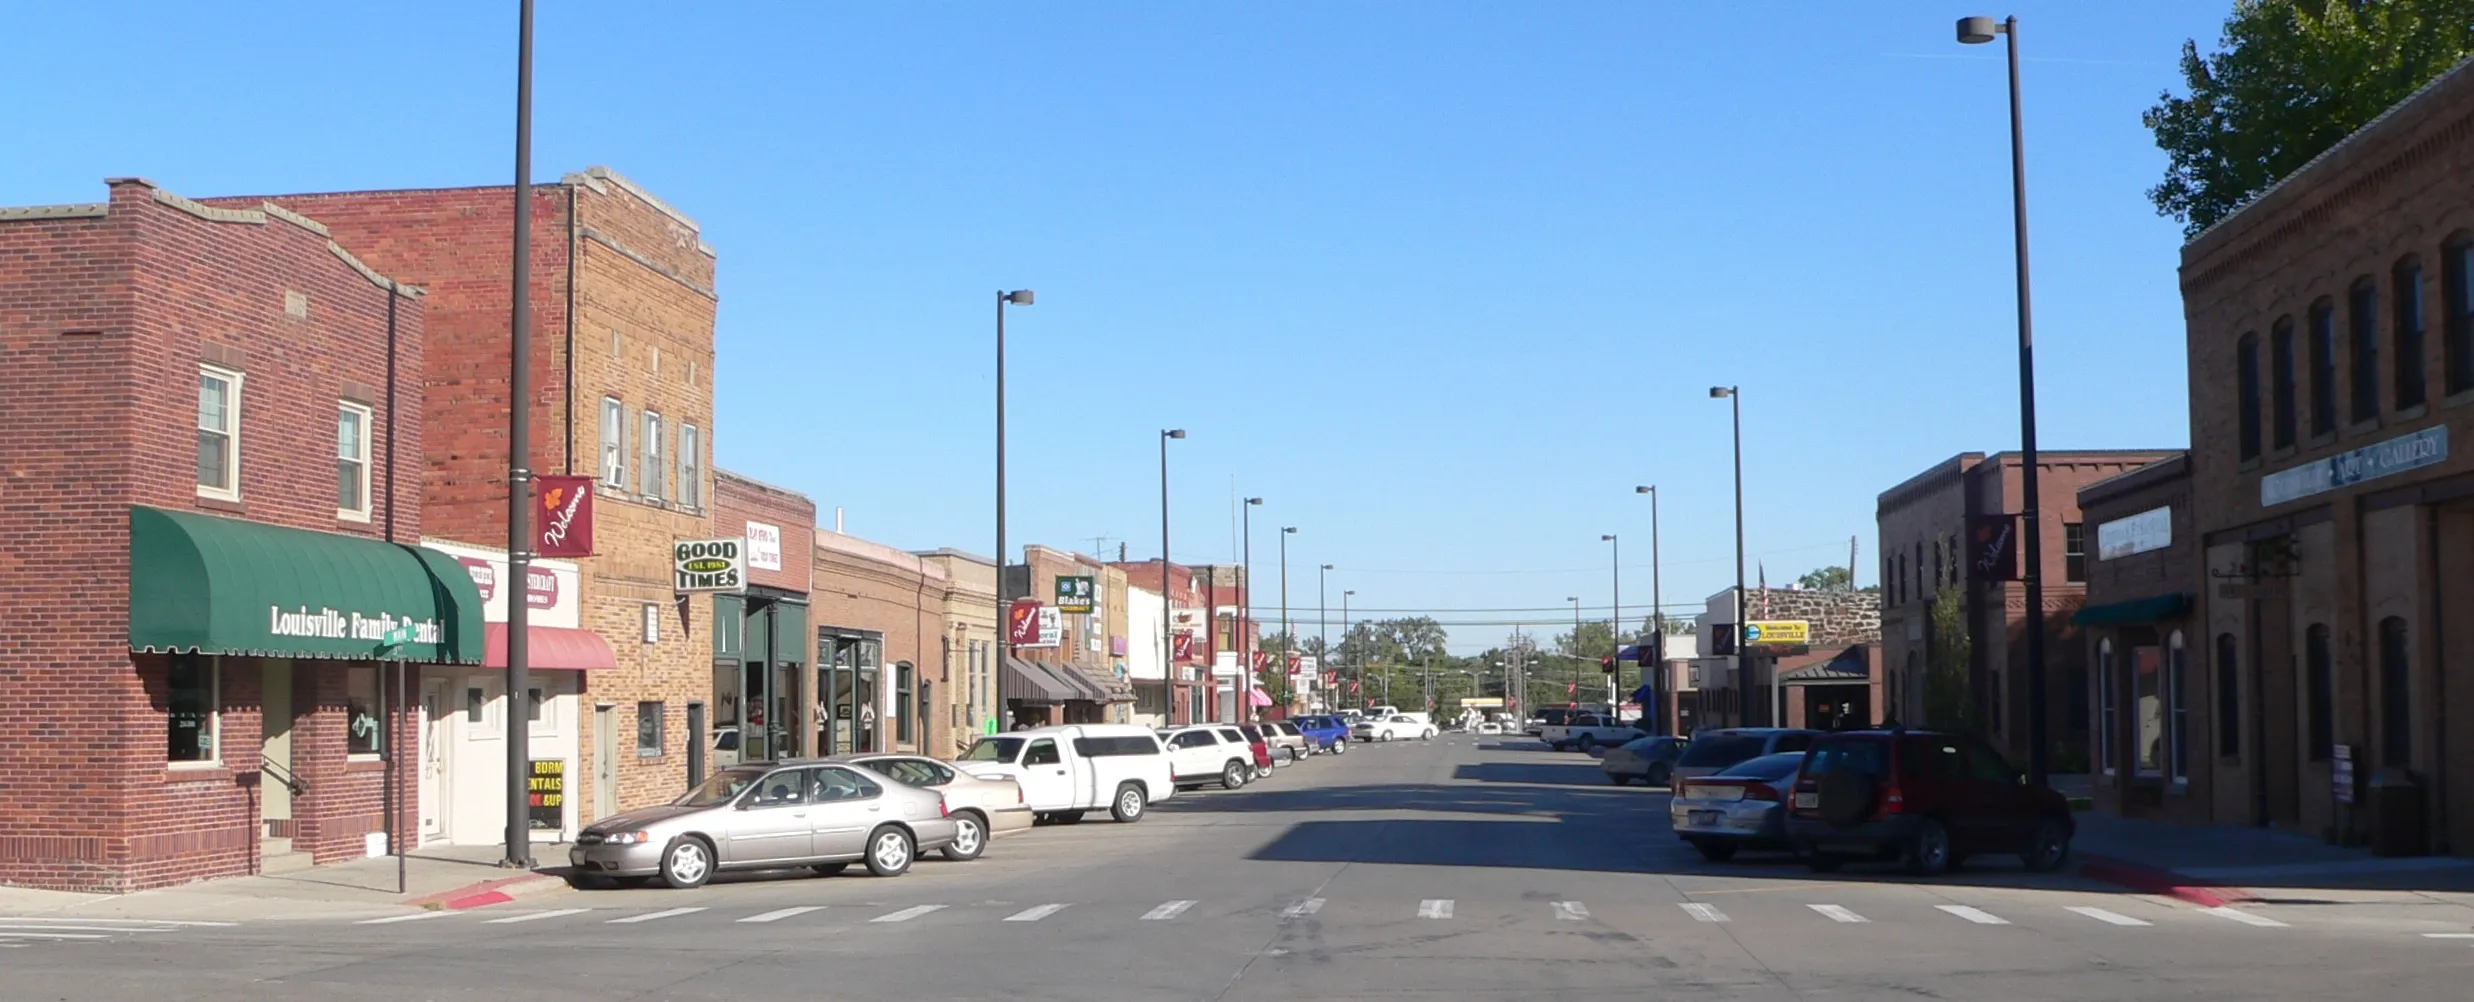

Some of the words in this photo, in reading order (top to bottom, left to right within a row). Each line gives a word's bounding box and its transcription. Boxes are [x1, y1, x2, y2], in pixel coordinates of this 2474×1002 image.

[2379, 435, 2439, 468] GALLERY
[544, 485, 585, 547] Welcome
[676, 541, 738, 562] GOOD
[1977, 523, 2011, 573] Welcome
[676, 567, 739, 588] TIMES
[1058, 595, 1090, 605] Blake's
[271, 605, 347, 638] Louisville
[352, 612, 398, 640] Family
[1013, 607, 1036, 639] Welcome
[1762, 631, 1805, 639] LOUISVILLE
[528, 777, 562, 790] NTALS
